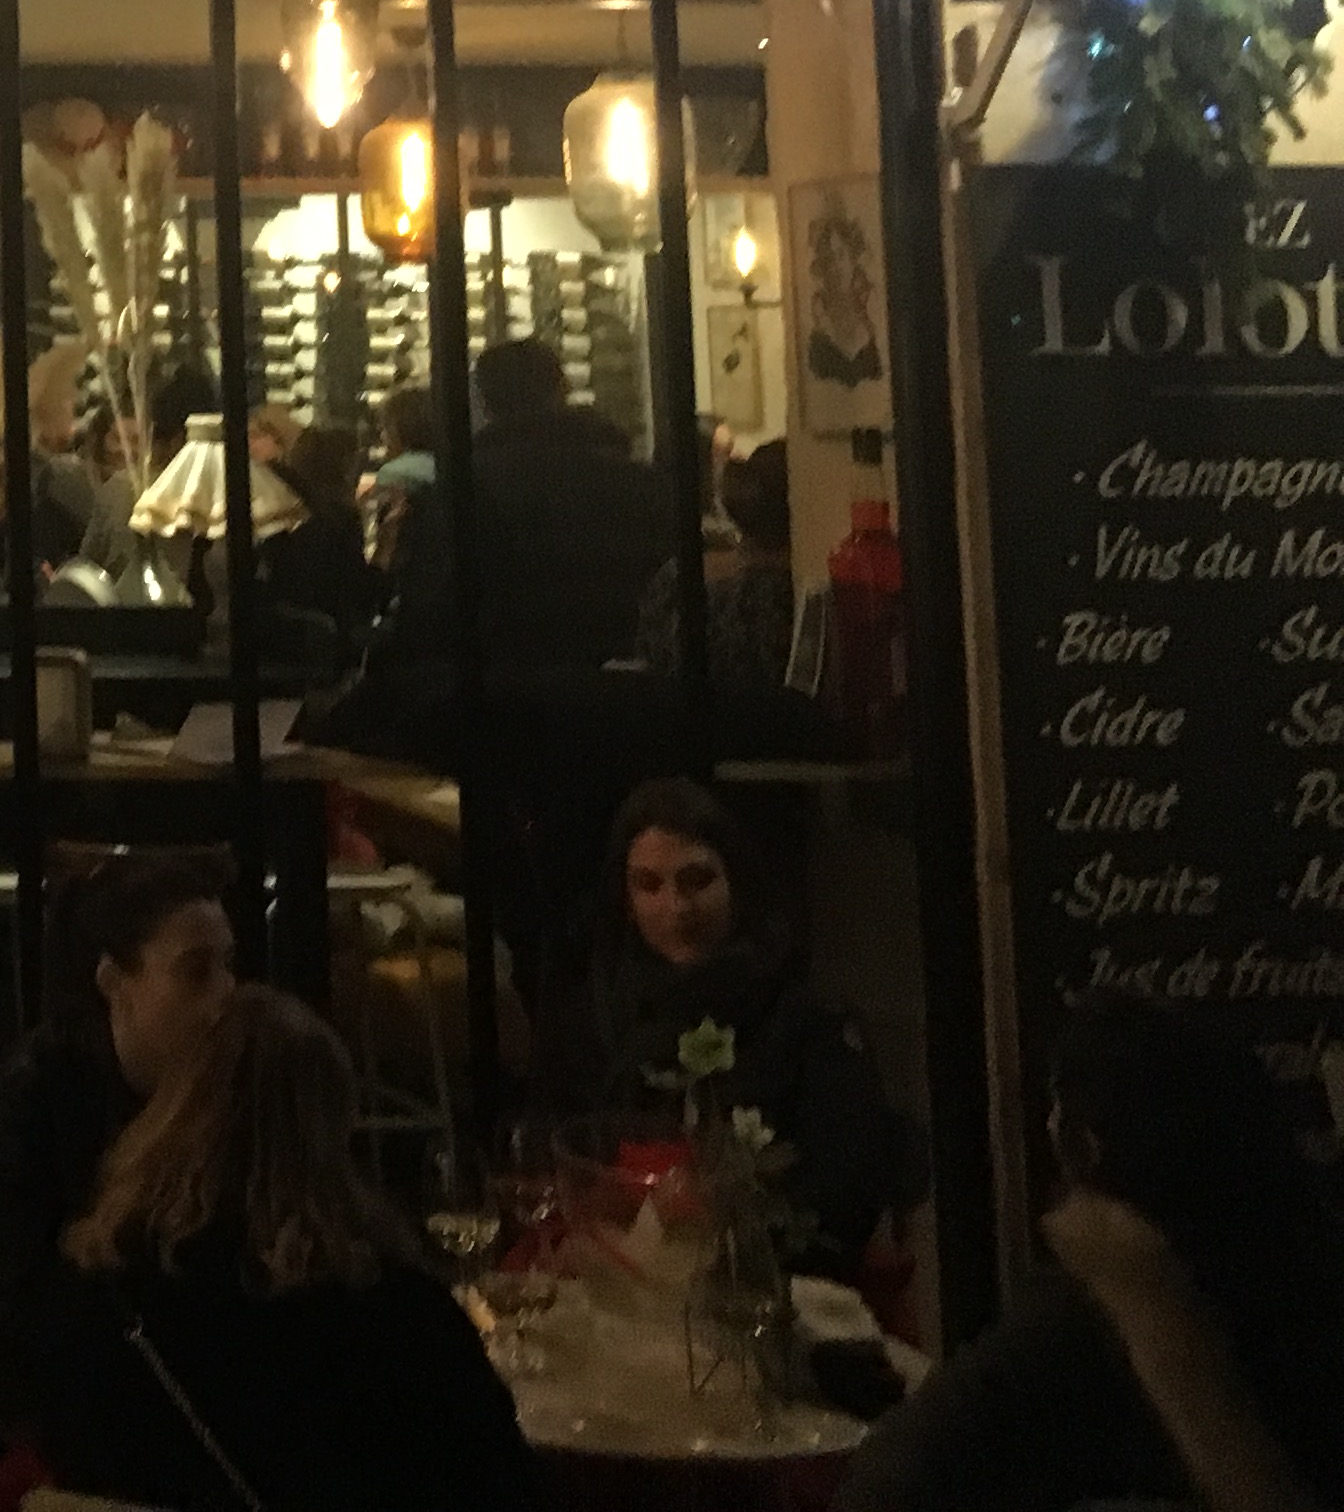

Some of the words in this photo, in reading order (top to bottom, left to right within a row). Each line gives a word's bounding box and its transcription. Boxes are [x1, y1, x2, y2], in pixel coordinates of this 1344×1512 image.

[1097, 437, 1344, 511] Champagn
[1094, 524, 1191, 582] Vins
[1192, 531, 1258, 581] du
[1055, 608, 1173, 666] Bière
[1058, 684, 1187, 748] Cidre
[1055, 776, 1181, 832] Lillet
[1063, 849, 1221, 926] Spritz
